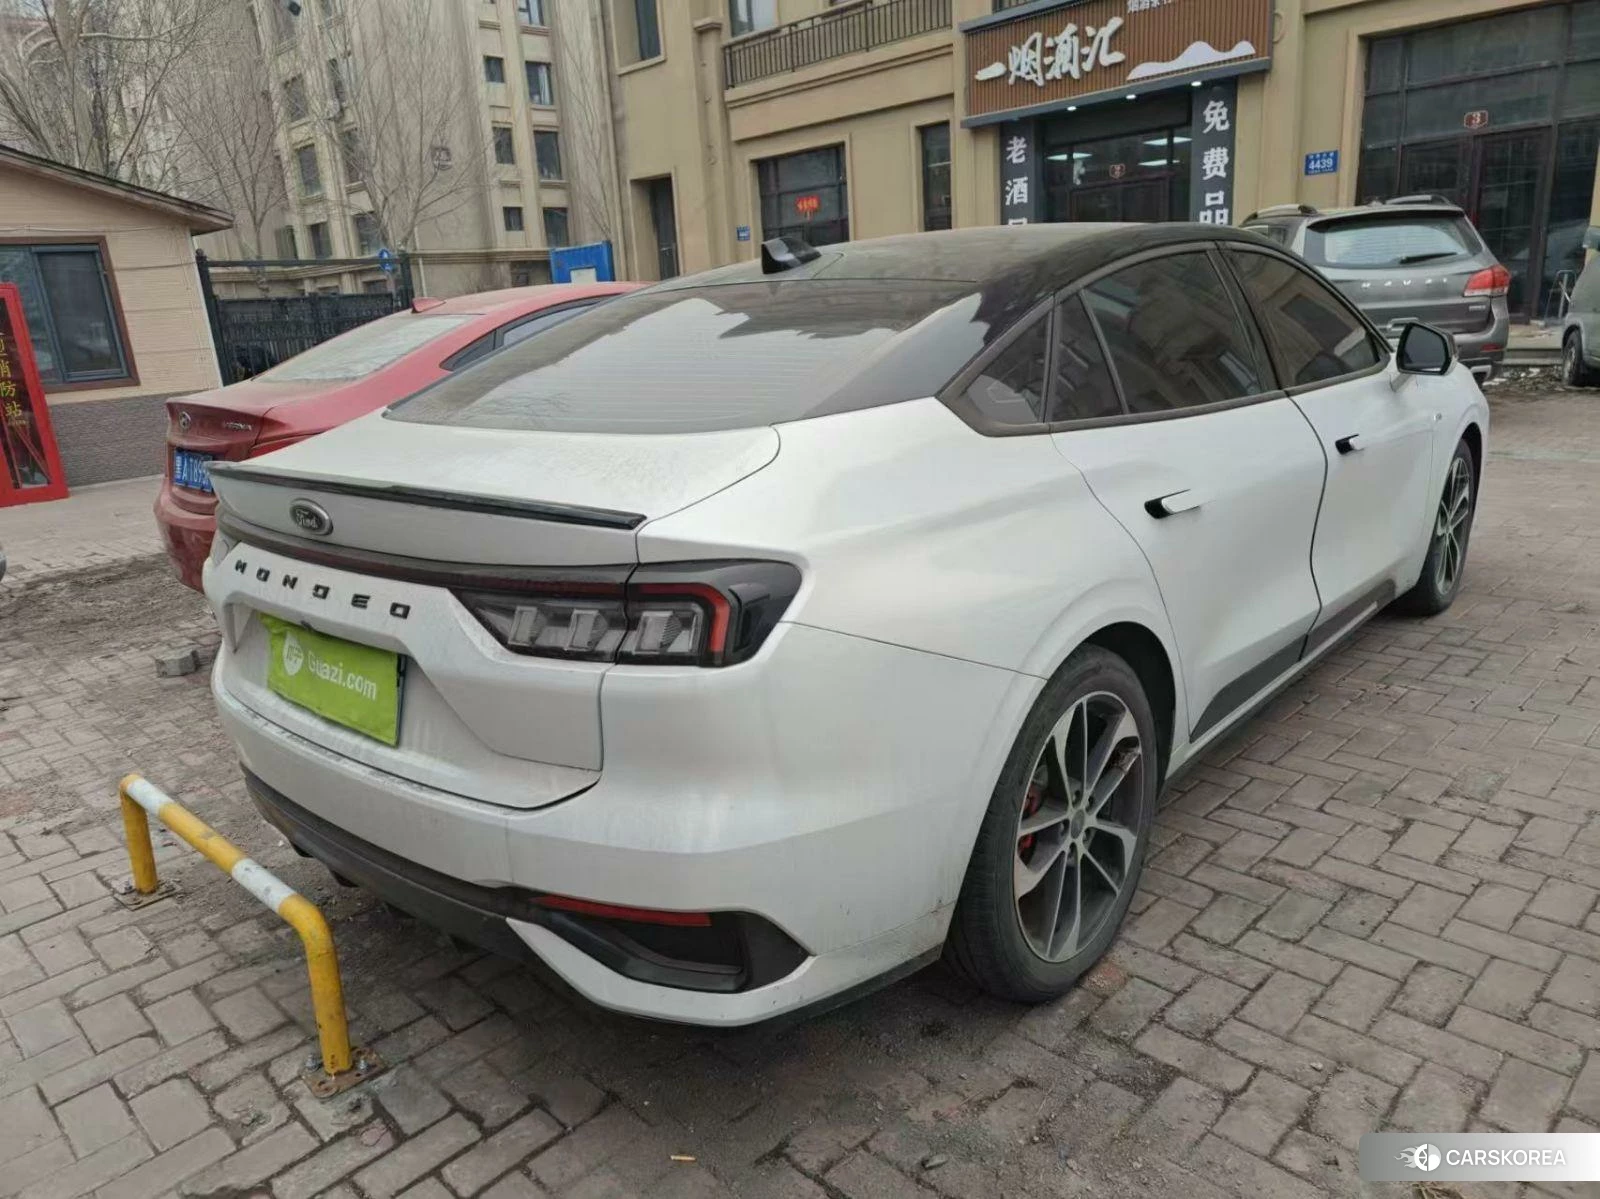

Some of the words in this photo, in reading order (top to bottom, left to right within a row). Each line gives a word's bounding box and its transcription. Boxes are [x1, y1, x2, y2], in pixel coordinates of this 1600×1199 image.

[1005, 135, 1028, 225] 老酒
[1308, 158, 1334, 170] 4439
[235, 559, 411, 620] MONDEO
[307, 650, 378, 701] Guazi.com
